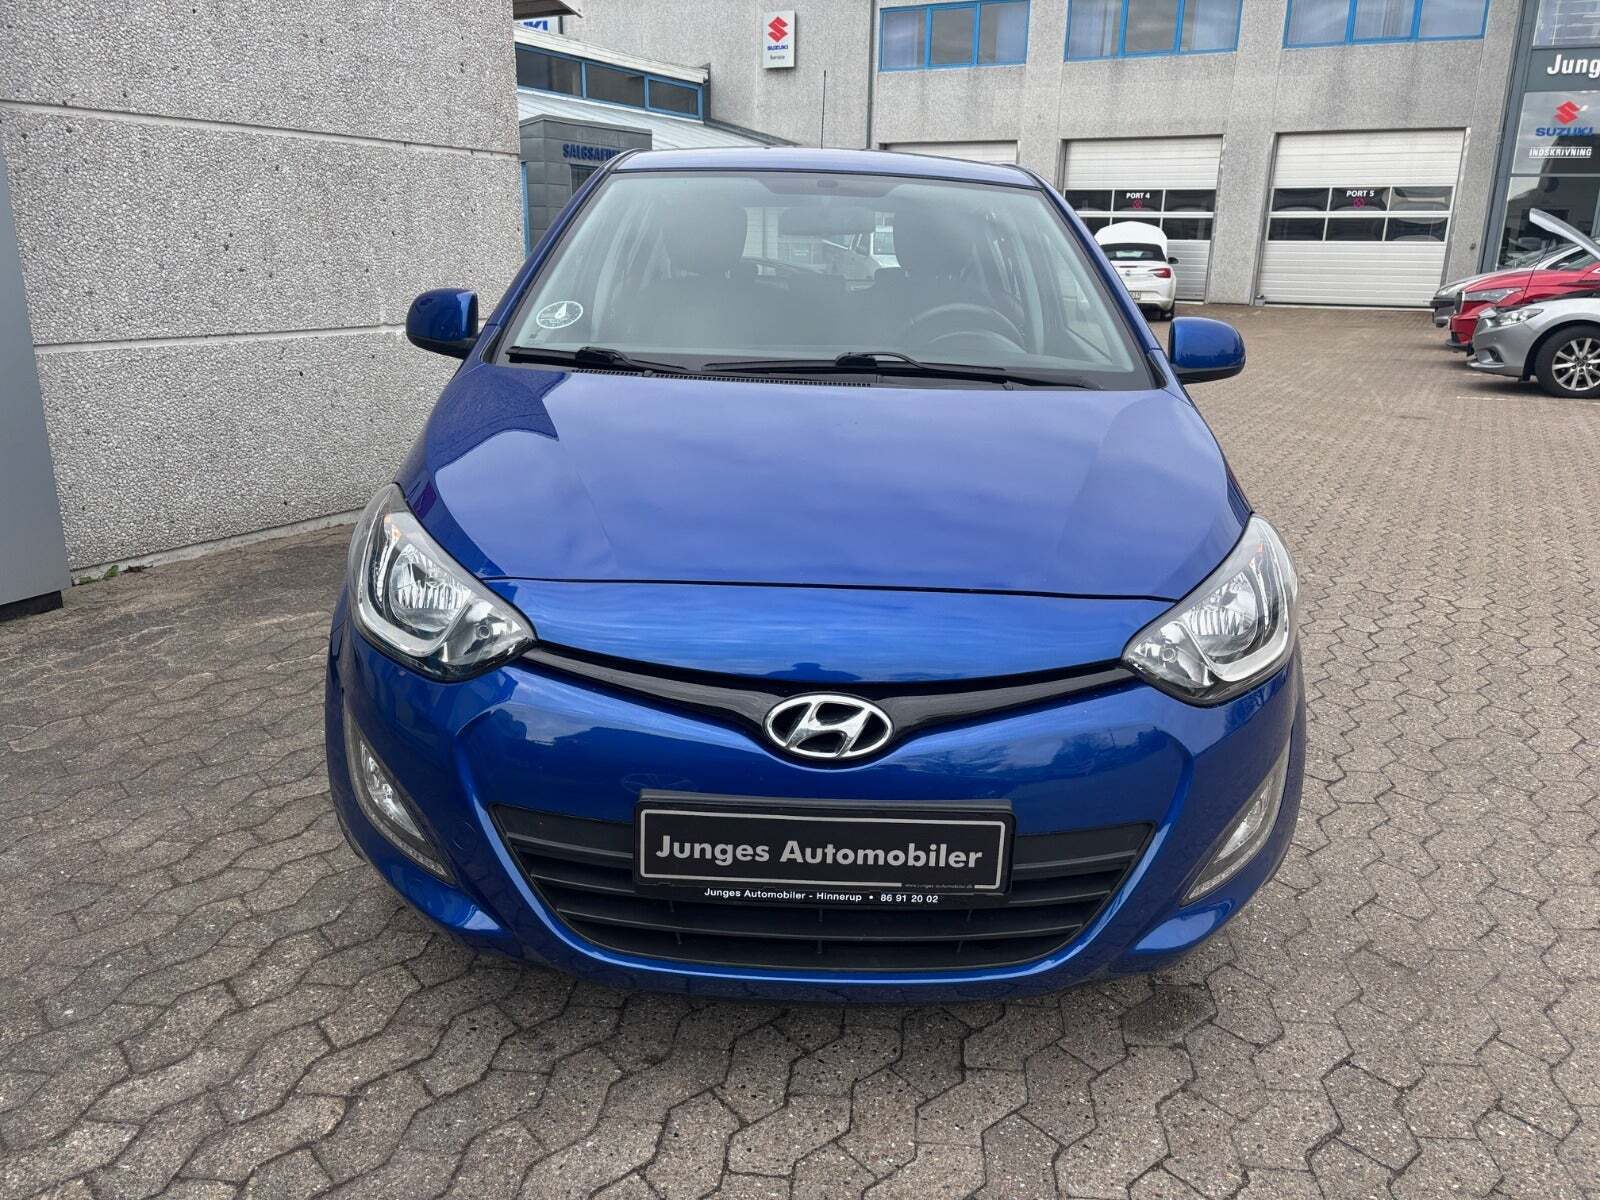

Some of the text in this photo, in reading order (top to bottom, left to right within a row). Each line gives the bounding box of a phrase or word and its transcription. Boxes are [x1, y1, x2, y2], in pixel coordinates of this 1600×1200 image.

[1535, 126, 1594, 137] SUZUKI
[1528, 147, 1592, 157] INDSKRIVNING
[655, 834, 983, 868] Junges Automobiler
[704, 887, 741, 899] Junges
[743, 889, 806, 900] Automobiler
[816, 892, 862, 902] Hinnerup
[880, 893, 893, 902] 86
[895, 894, 907, 903] 91
[911, 894, 923, 903] 20
[926, 895, 939, 904] 02
